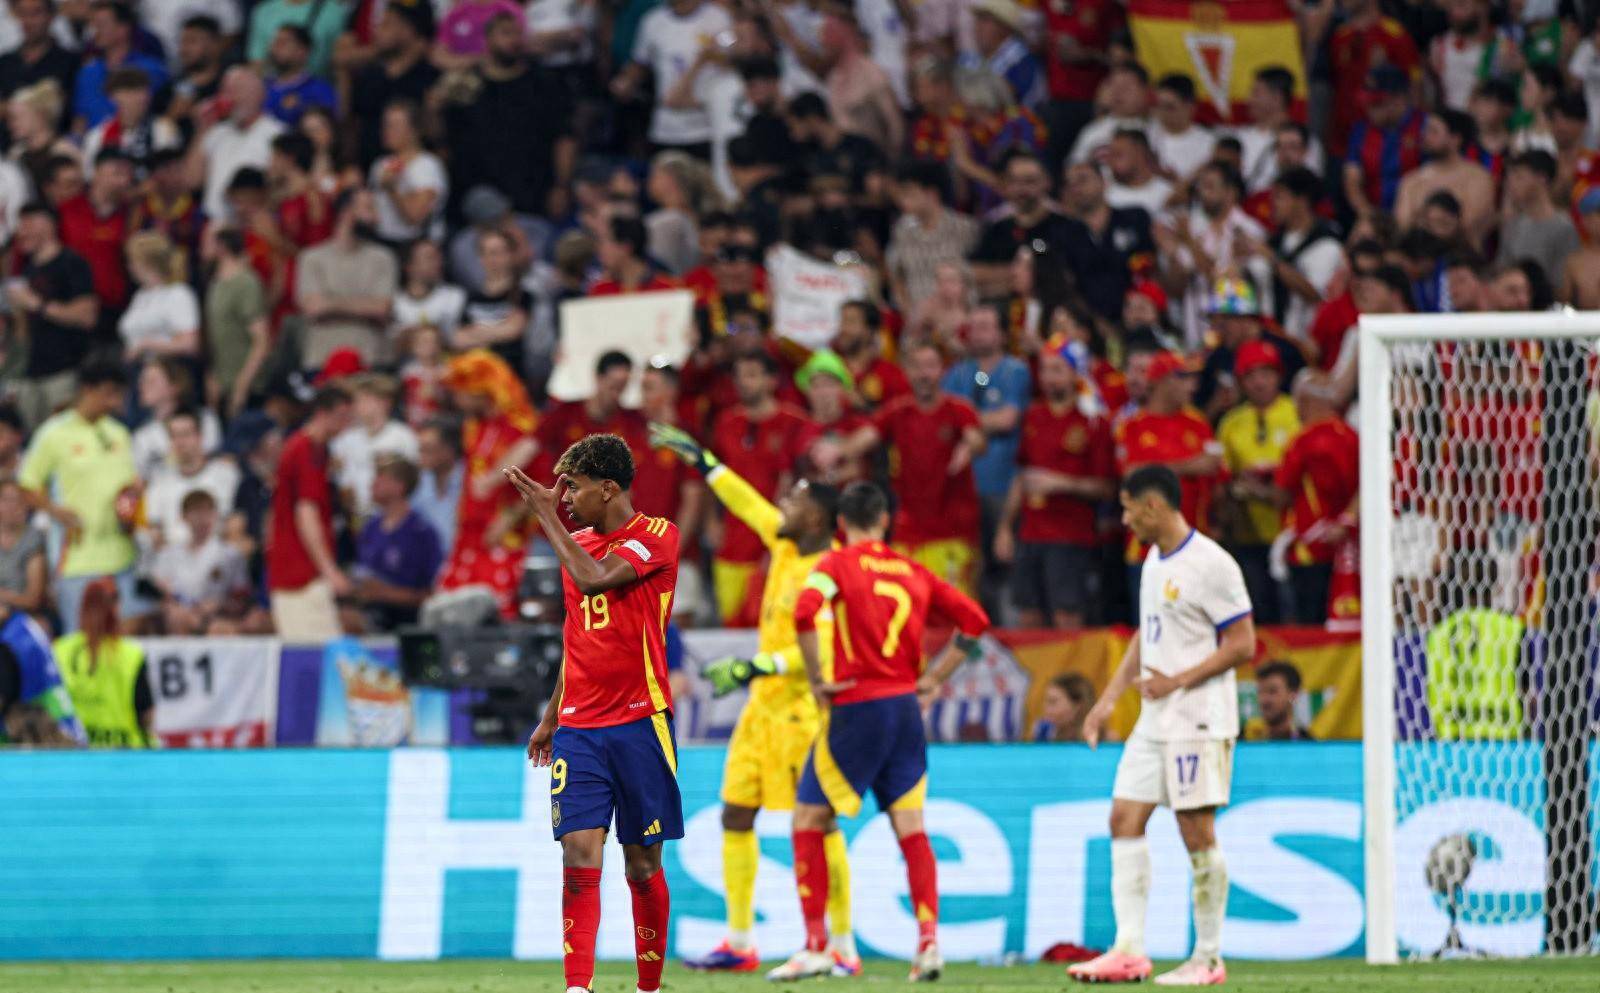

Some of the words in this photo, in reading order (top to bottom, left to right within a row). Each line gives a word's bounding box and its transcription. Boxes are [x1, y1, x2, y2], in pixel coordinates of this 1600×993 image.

[580, 593, 610, 631] 19
[873, 580, 911, 658] 7
[160, 654, 214, 700] B1
[1176, 754, 1199, 785] 17
